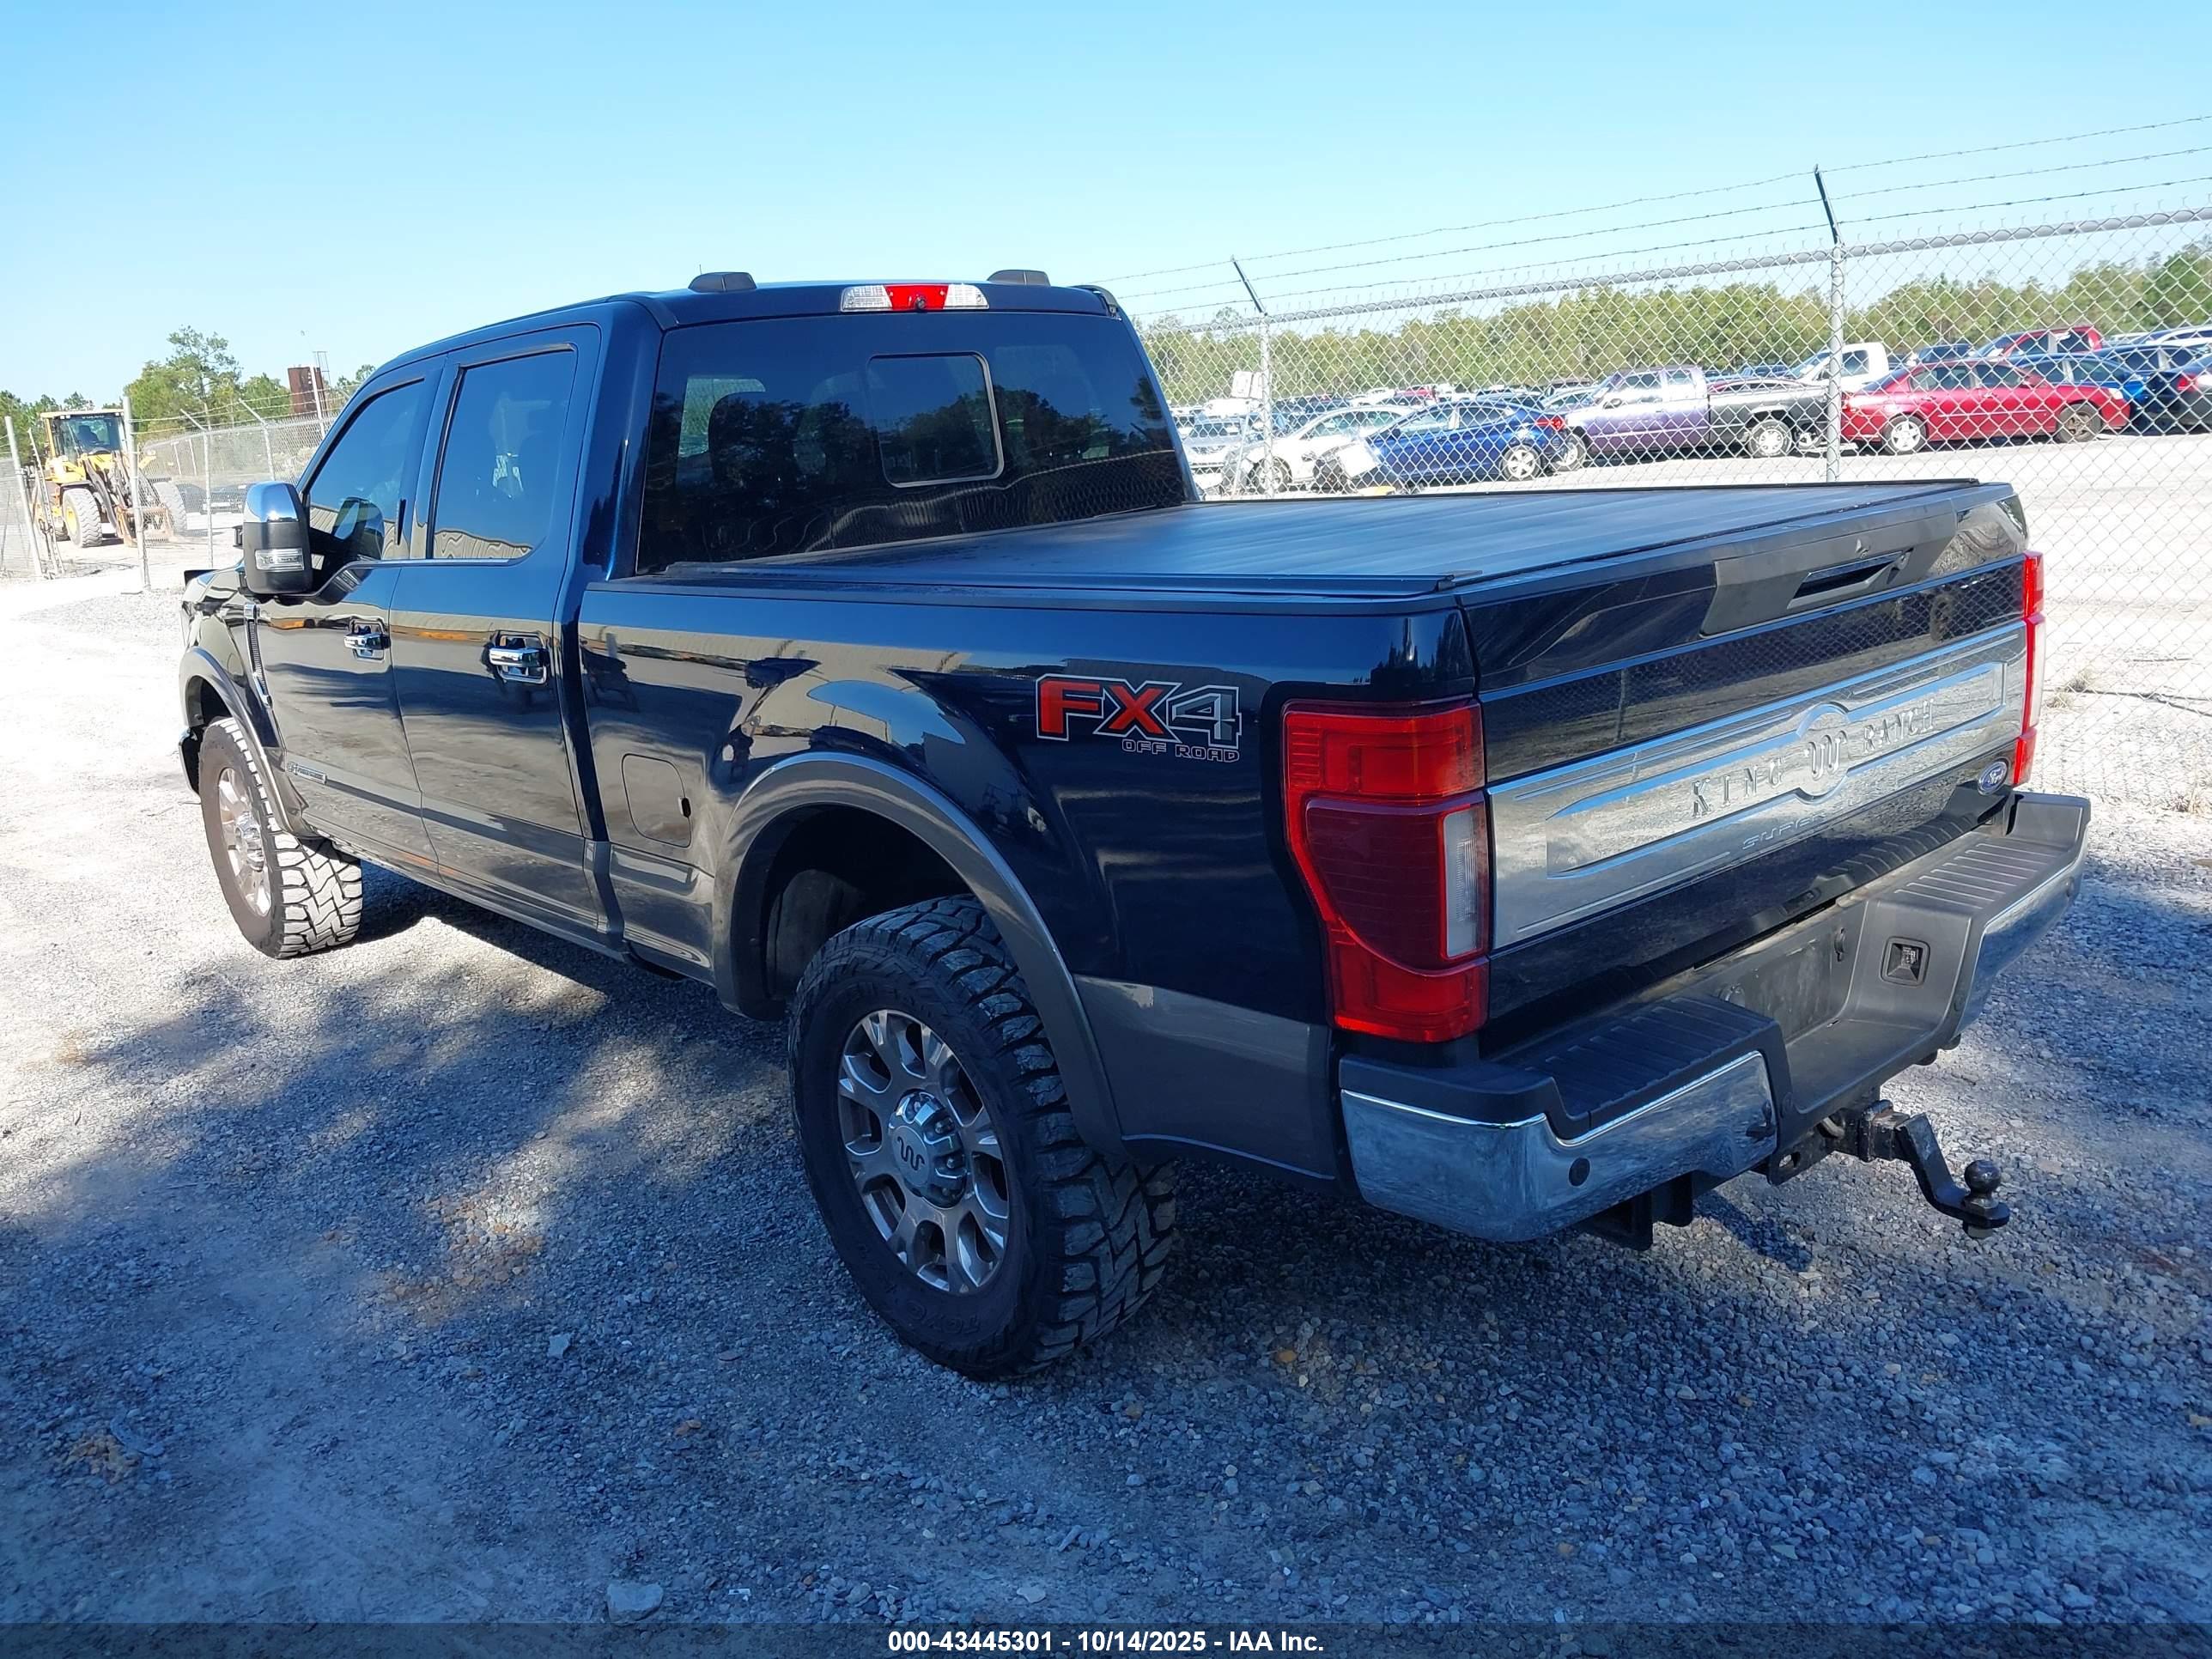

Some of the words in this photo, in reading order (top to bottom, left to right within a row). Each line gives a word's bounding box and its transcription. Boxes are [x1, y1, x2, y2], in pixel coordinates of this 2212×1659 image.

[1036, 673, 1242, 750] FX4
[1121, 738, 1167, 756] OFF
[1175, 745, 1240, 763] ROAD
[1692, 757, 1786, 817] KING
[1863, 698, 1935, 754] RANCH
